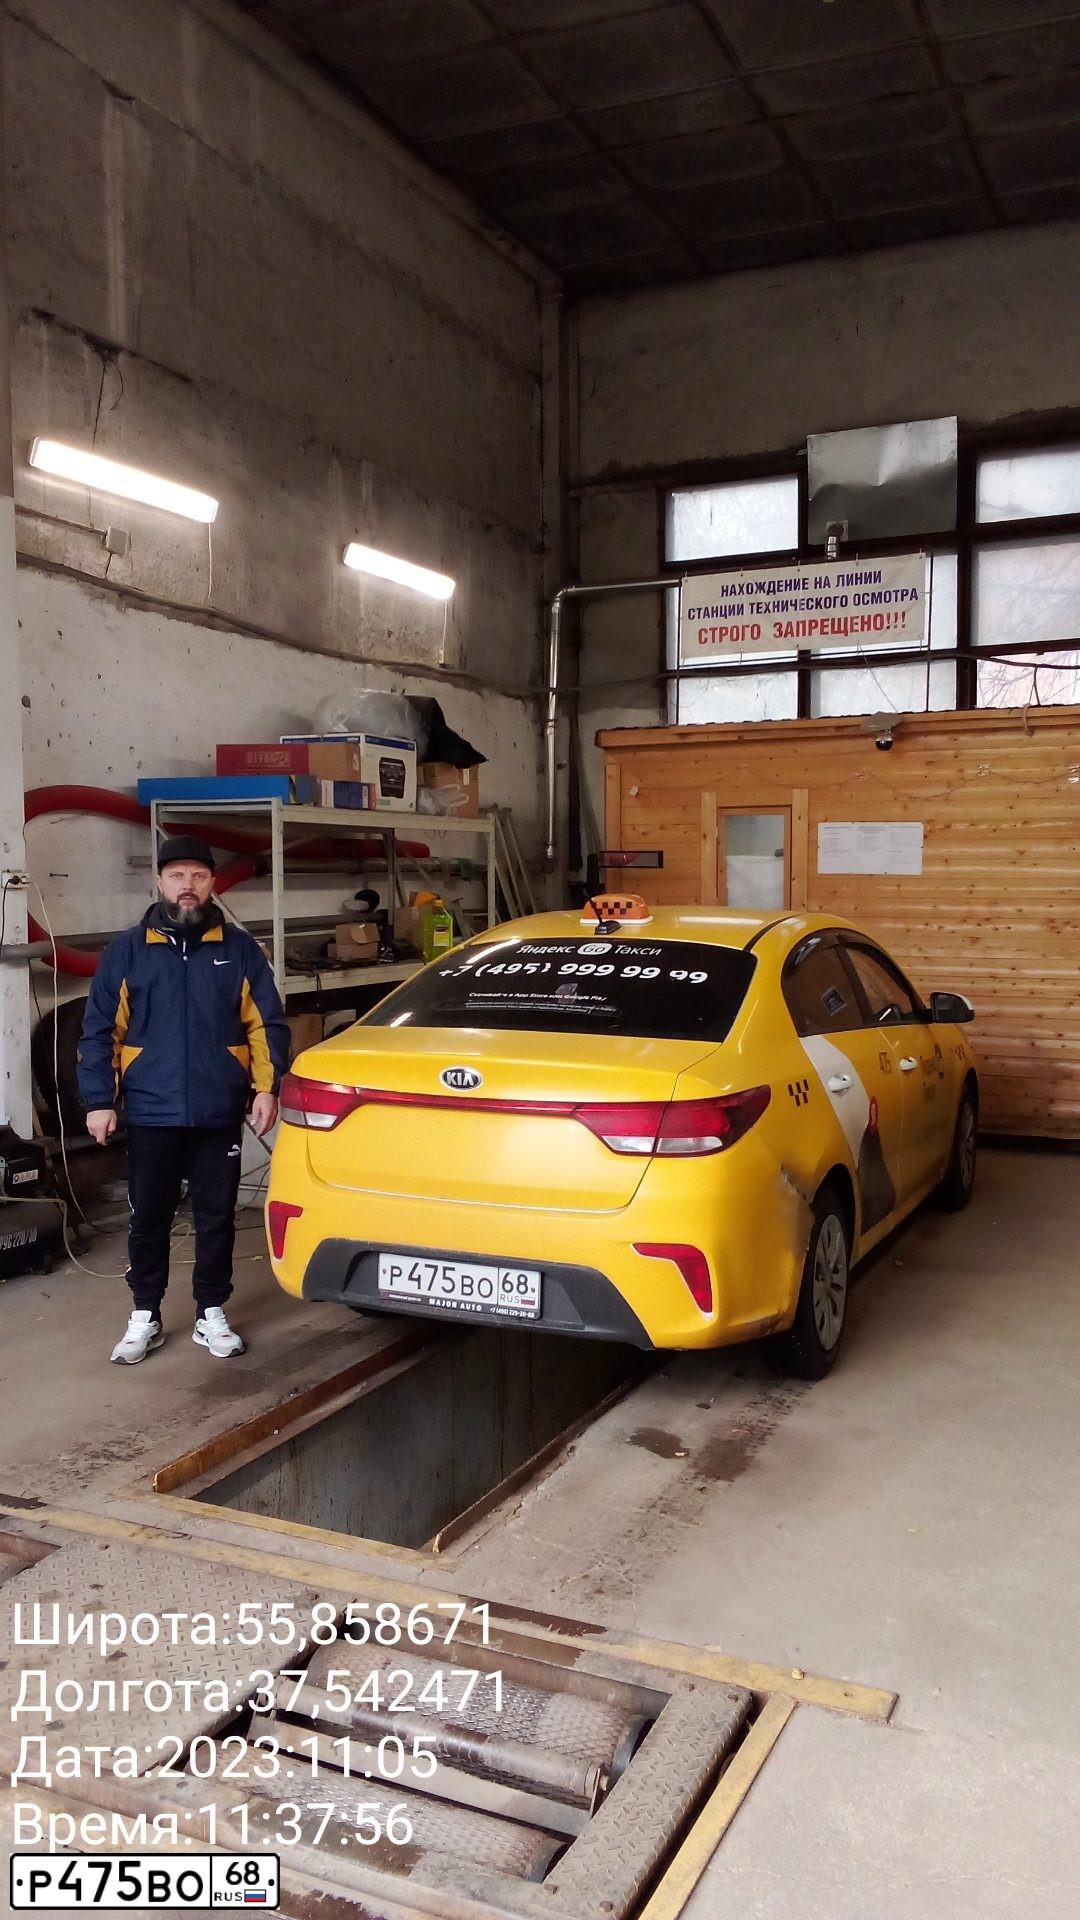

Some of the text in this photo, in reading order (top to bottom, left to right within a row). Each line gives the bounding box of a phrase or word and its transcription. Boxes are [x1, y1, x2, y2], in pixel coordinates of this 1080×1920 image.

[721, 570, 882, 597] НАХОЖДЕНИЕ НА ЛИНИИ
[687, 587, 919, 621] СТАНЦИИ ТЕХНИЧЕСКОГО ОСМОТРА
[697, 611, 907, 645] СТРОГО ЗАПРЕЩЕНО!!!
[516, 944, 576, 954] Яндекс
[614, 944, 662, 956] Такси
[438, 962, 708, 984] +7 (495) 999 99 99
[446, 1071, 473, 1086] KIA
[501, 1271, 529, 1295] 68
[428, 1298, 457, 1308] MAJOR
[460, 1303, 483, 1311] AUTO
[500, 1293, 520, 1304] RUS
